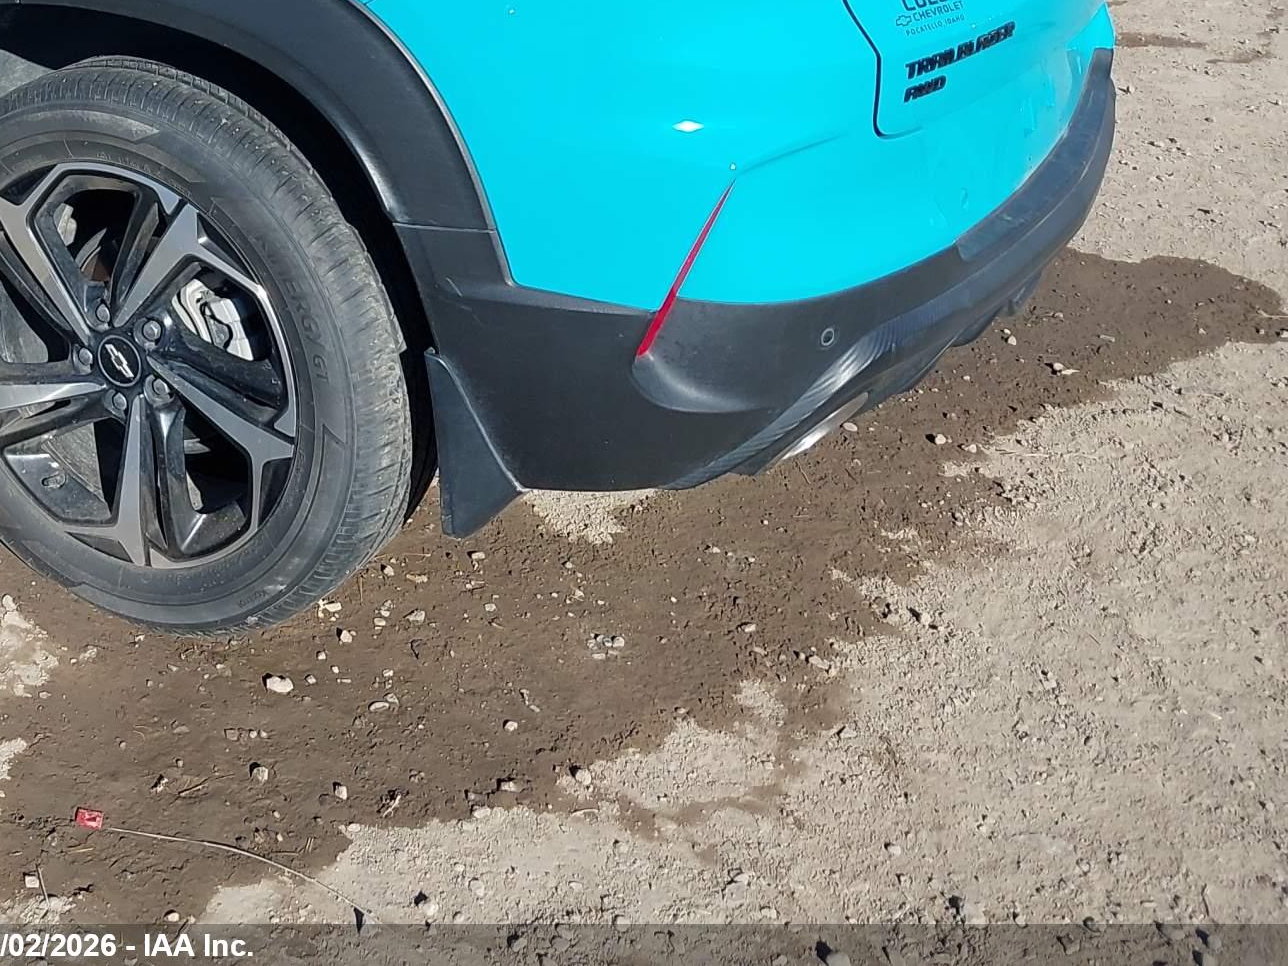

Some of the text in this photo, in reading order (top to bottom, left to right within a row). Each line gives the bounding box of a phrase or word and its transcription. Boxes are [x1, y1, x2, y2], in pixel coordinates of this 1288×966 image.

[912, 0, 965, 22] CHEVROLET
[905, 21, 1016, 80] TRAILBLAZER
[903, 75, 947, 103] AWD
